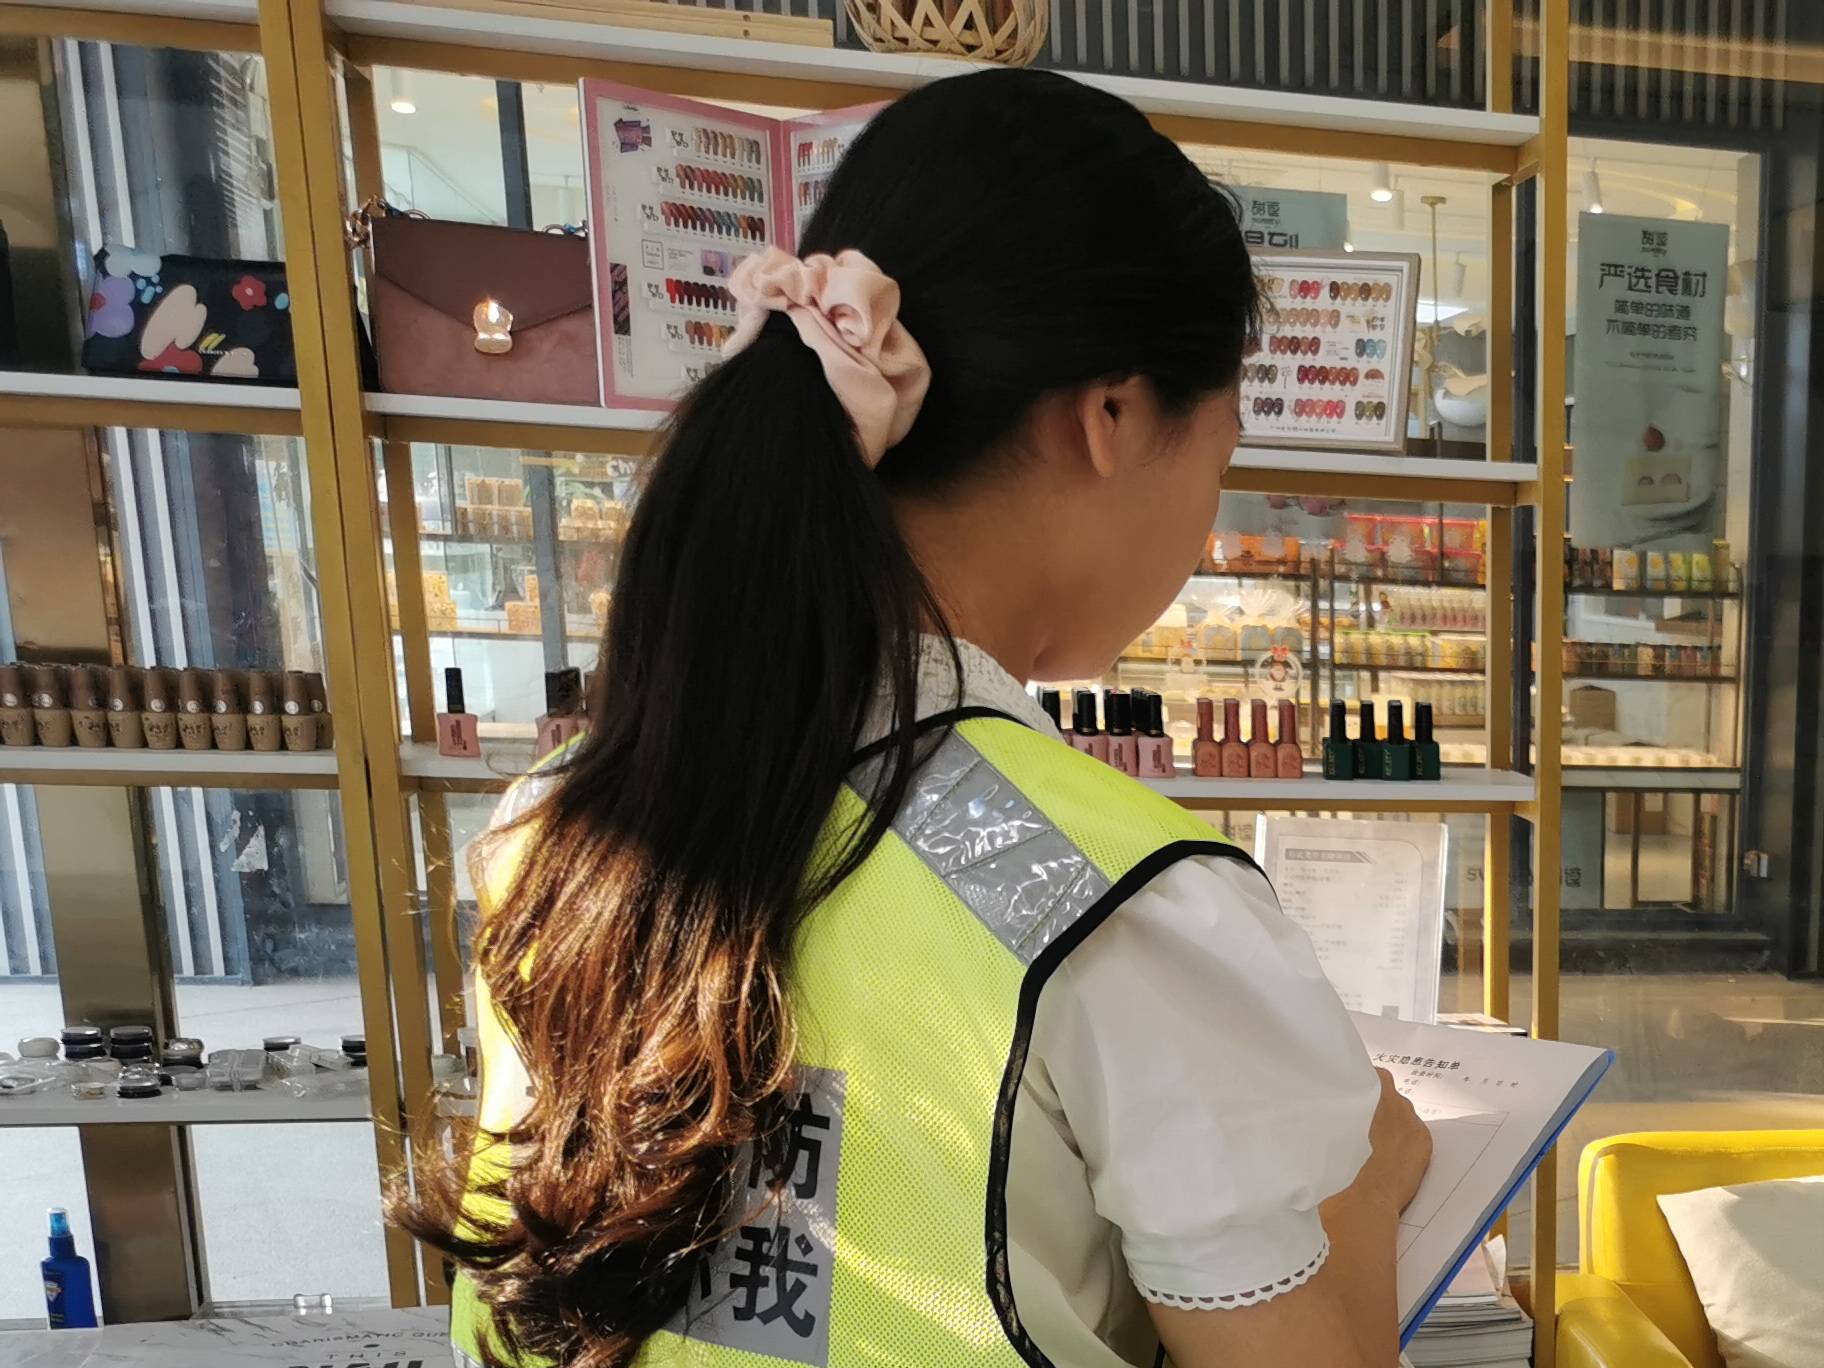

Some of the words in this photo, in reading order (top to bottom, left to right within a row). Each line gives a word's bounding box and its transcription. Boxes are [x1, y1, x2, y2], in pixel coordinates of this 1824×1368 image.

[1599, 263, 1708, 298] 严选食材
[1614, 299, 1692, 321] 简单的味道
[1373, 1053, 1461, 1070] 火灾隐患告知单
